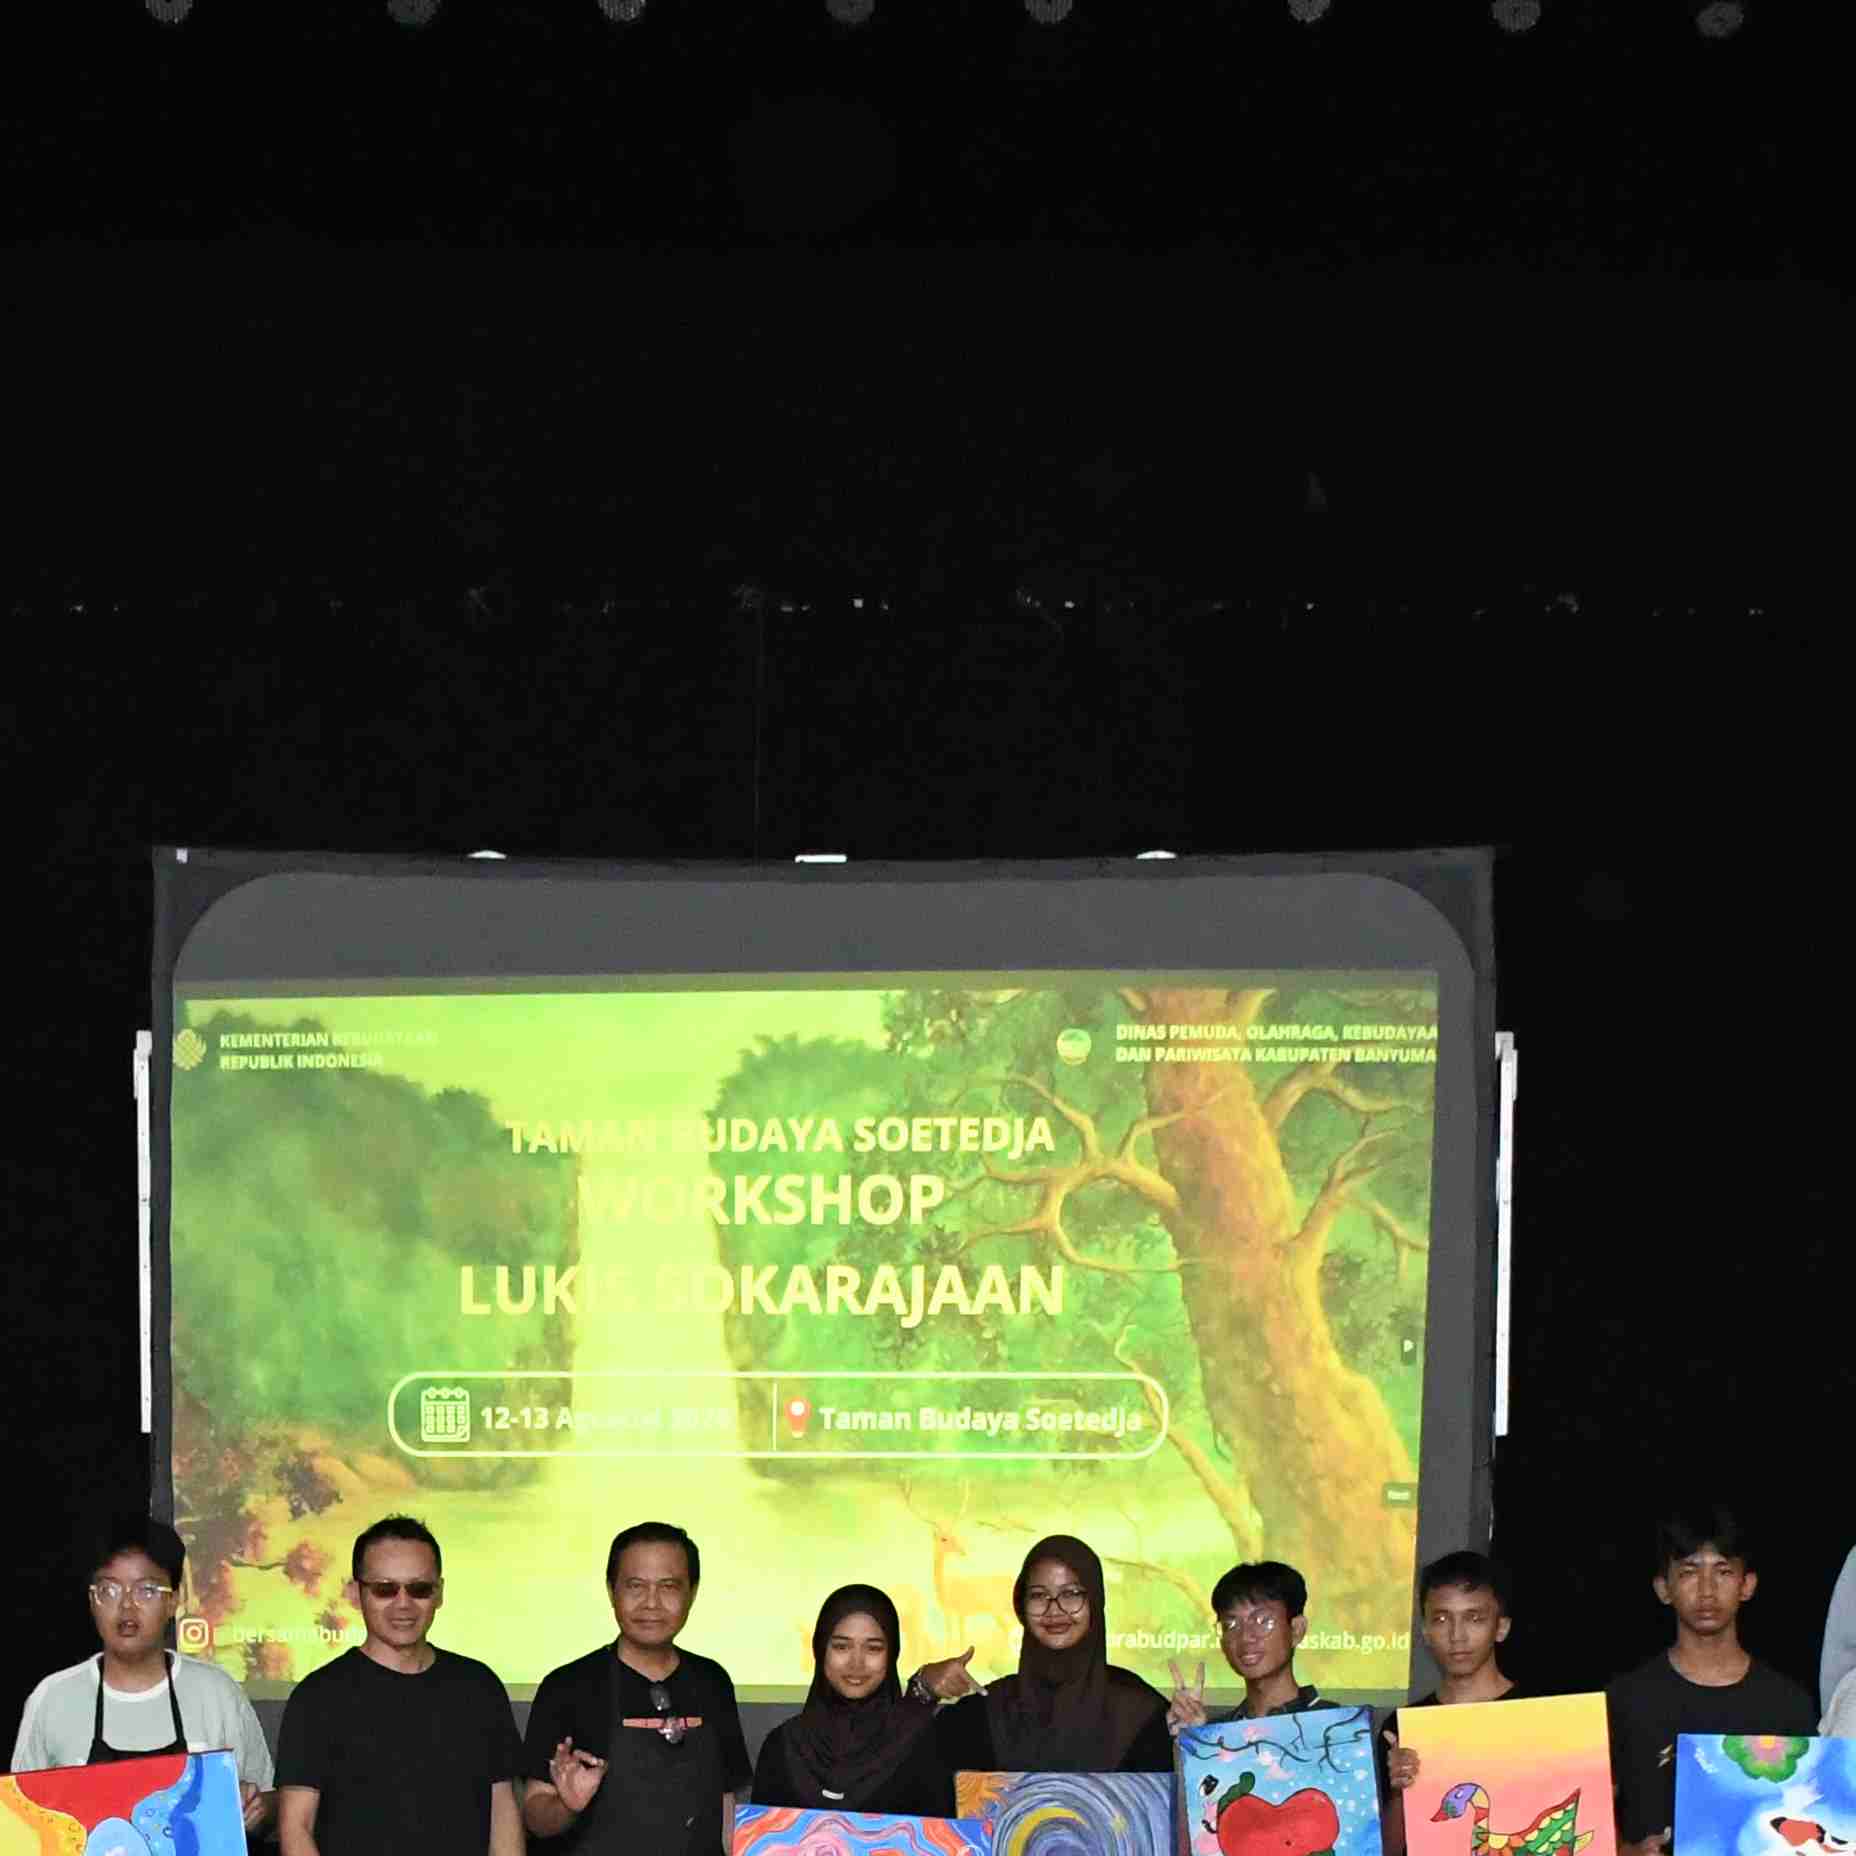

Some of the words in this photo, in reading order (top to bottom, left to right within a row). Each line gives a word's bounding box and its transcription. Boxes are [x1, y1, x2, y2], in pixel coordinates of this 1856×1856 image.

[219, 1033, 328, 1049] KEMENTERIAN
[1115, 1024, 1166, 1041] DINAS
[1343, 1024, 1438, 1040] KEBUDAYAA
[219, 1055, 293, 1070] REPUBLIK
[1115, 1046, 1152, 1063] DAN
[1155, 1046, 1250, 1063] PARIWISATA
[1254, 1046, 1350, 1063] KABUPATEN
[1354, 1046, 1437, 1063] BANYUMA
[853, 1116, 1056, 1159] SOETEDJA
[578, 1174, 946, 1226] WORKSHOP
[481, 1407, 548, 1429] 12-13
[819, 1407, 911, 1430] Taman
[919, 1406, 1017, 1436] Budaya
[1024, 1406, 1142, 1437] Soetedja
